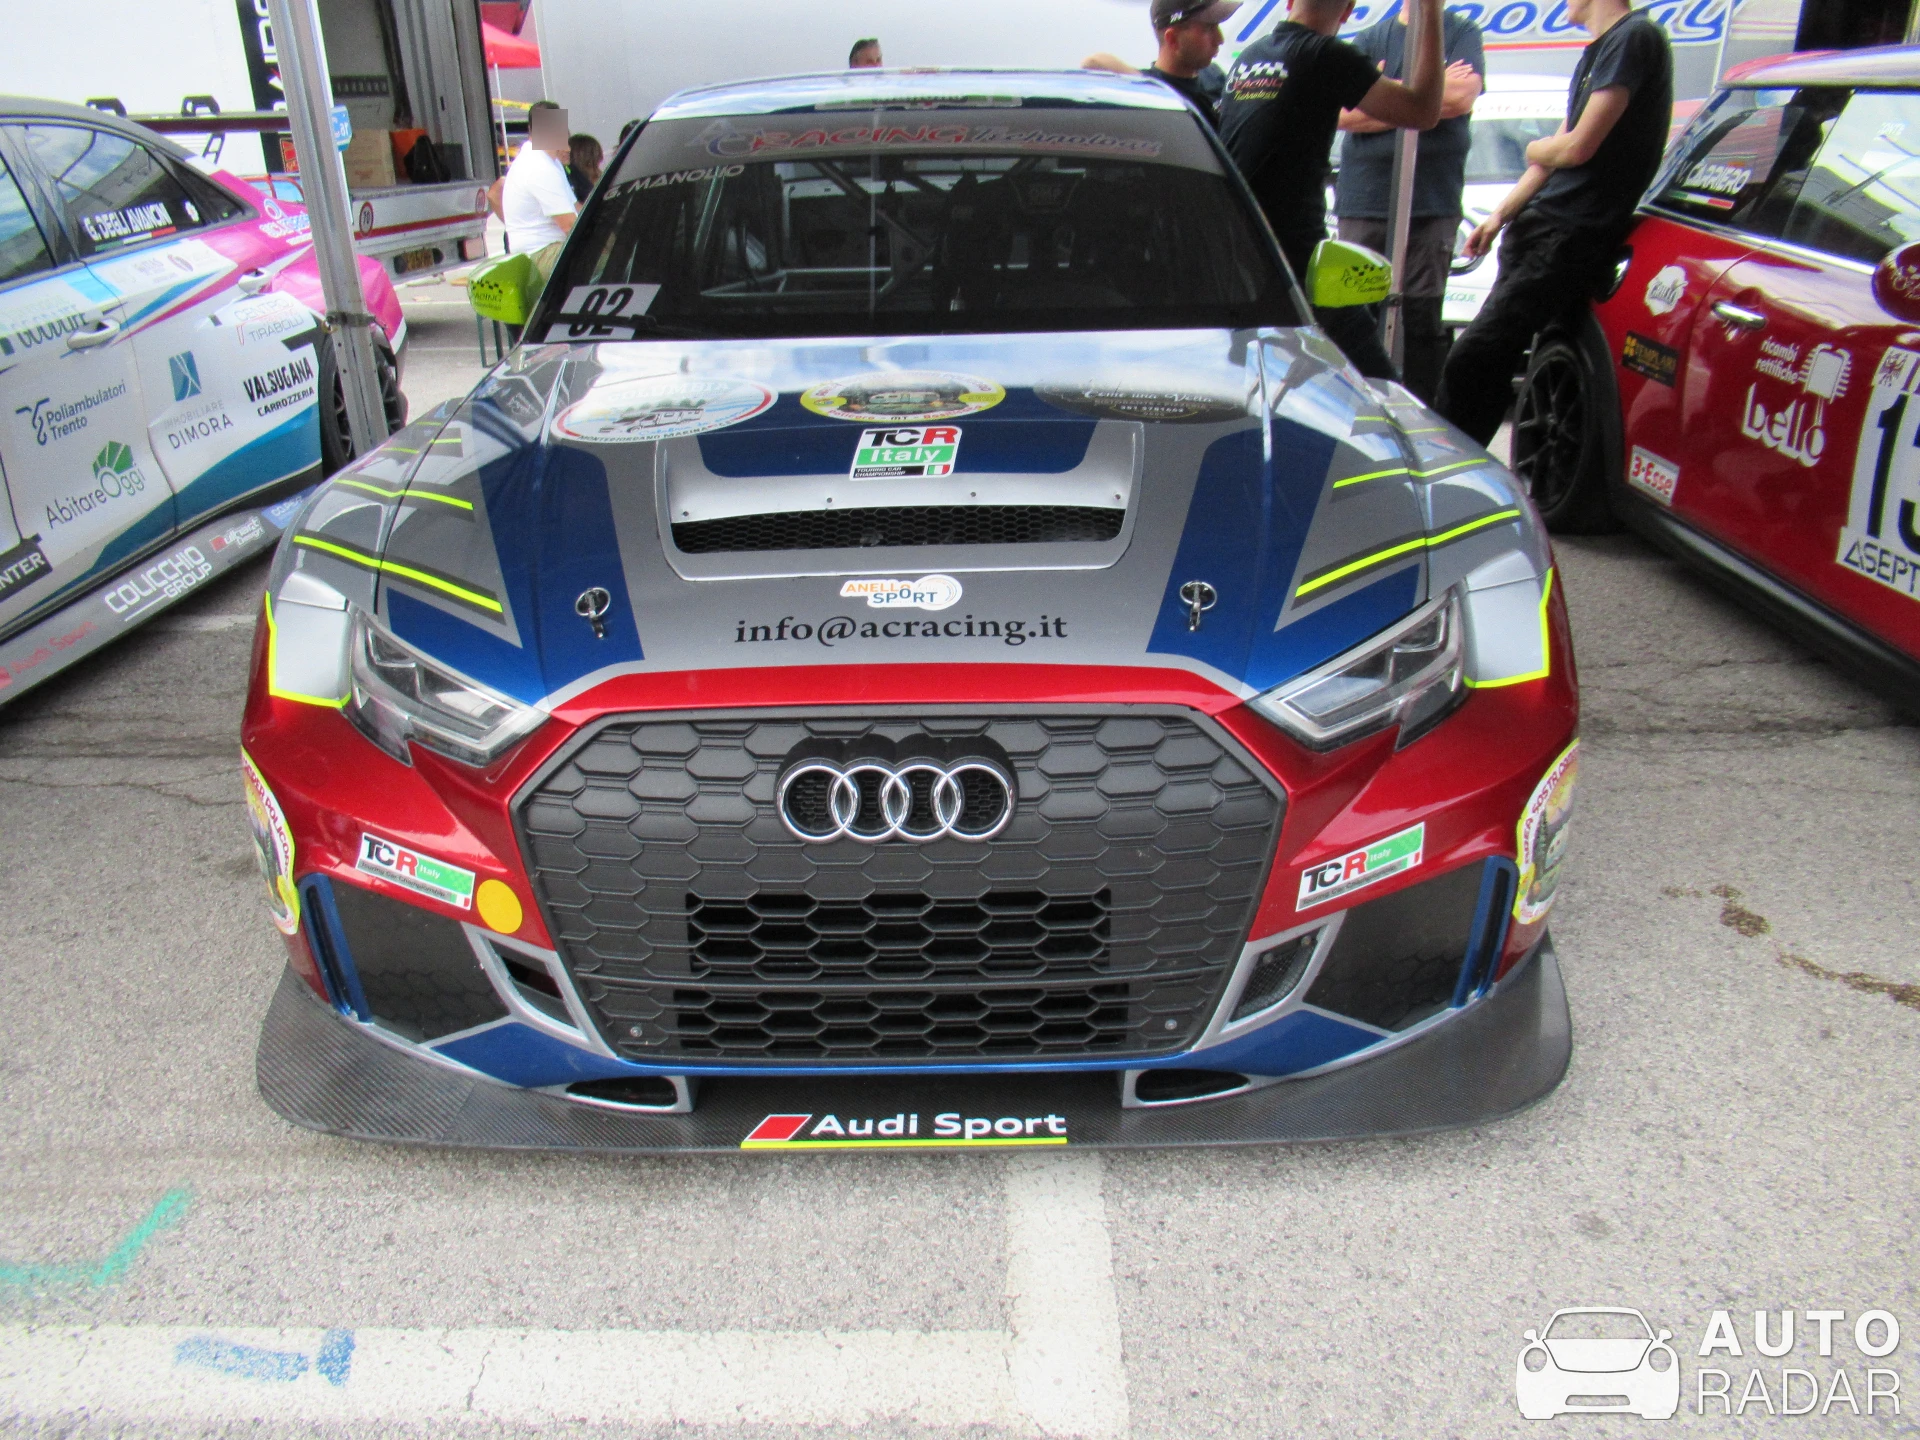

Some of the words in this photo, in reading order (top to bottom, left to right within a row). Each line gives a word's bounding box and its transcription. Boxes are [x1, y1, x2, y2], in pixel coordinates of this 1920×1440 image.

[752, 125, 969, 151] RACING
[568, 287, 635, 338] 02
[1761, 335, 1800, 363] ricambi
[243, 356, 315, 402] VALSUGANA
[1755, 357, 1801, 385] rettifiche
[46, 379, 127, 424] Poliambulatori
[256, 386, 315, 418] CARROZZERIA
[50, 416, 88, 442] Trento
[167, 413, 234, 450] DIMORA
[863, 426, 959, 447] TCR
[1742, 382, 1826, 468] bello
[104, 546, 207, 614] COLICCHIO
[163, 562, 214, 599] GROUP
[845, 582, 912, 594] ANELLO
[872, 587, 939, 605] SPORT
[733, 614, 1068, 647] info@acracing.it
[363, 836, 419, 877] TCR
[419, 864, 441, 880] Italy
[1303, 850, 1368, 894] TCR
[810, 1113, 919, 1136] Audi
[933, 1112, 1068, 1140] Sport
